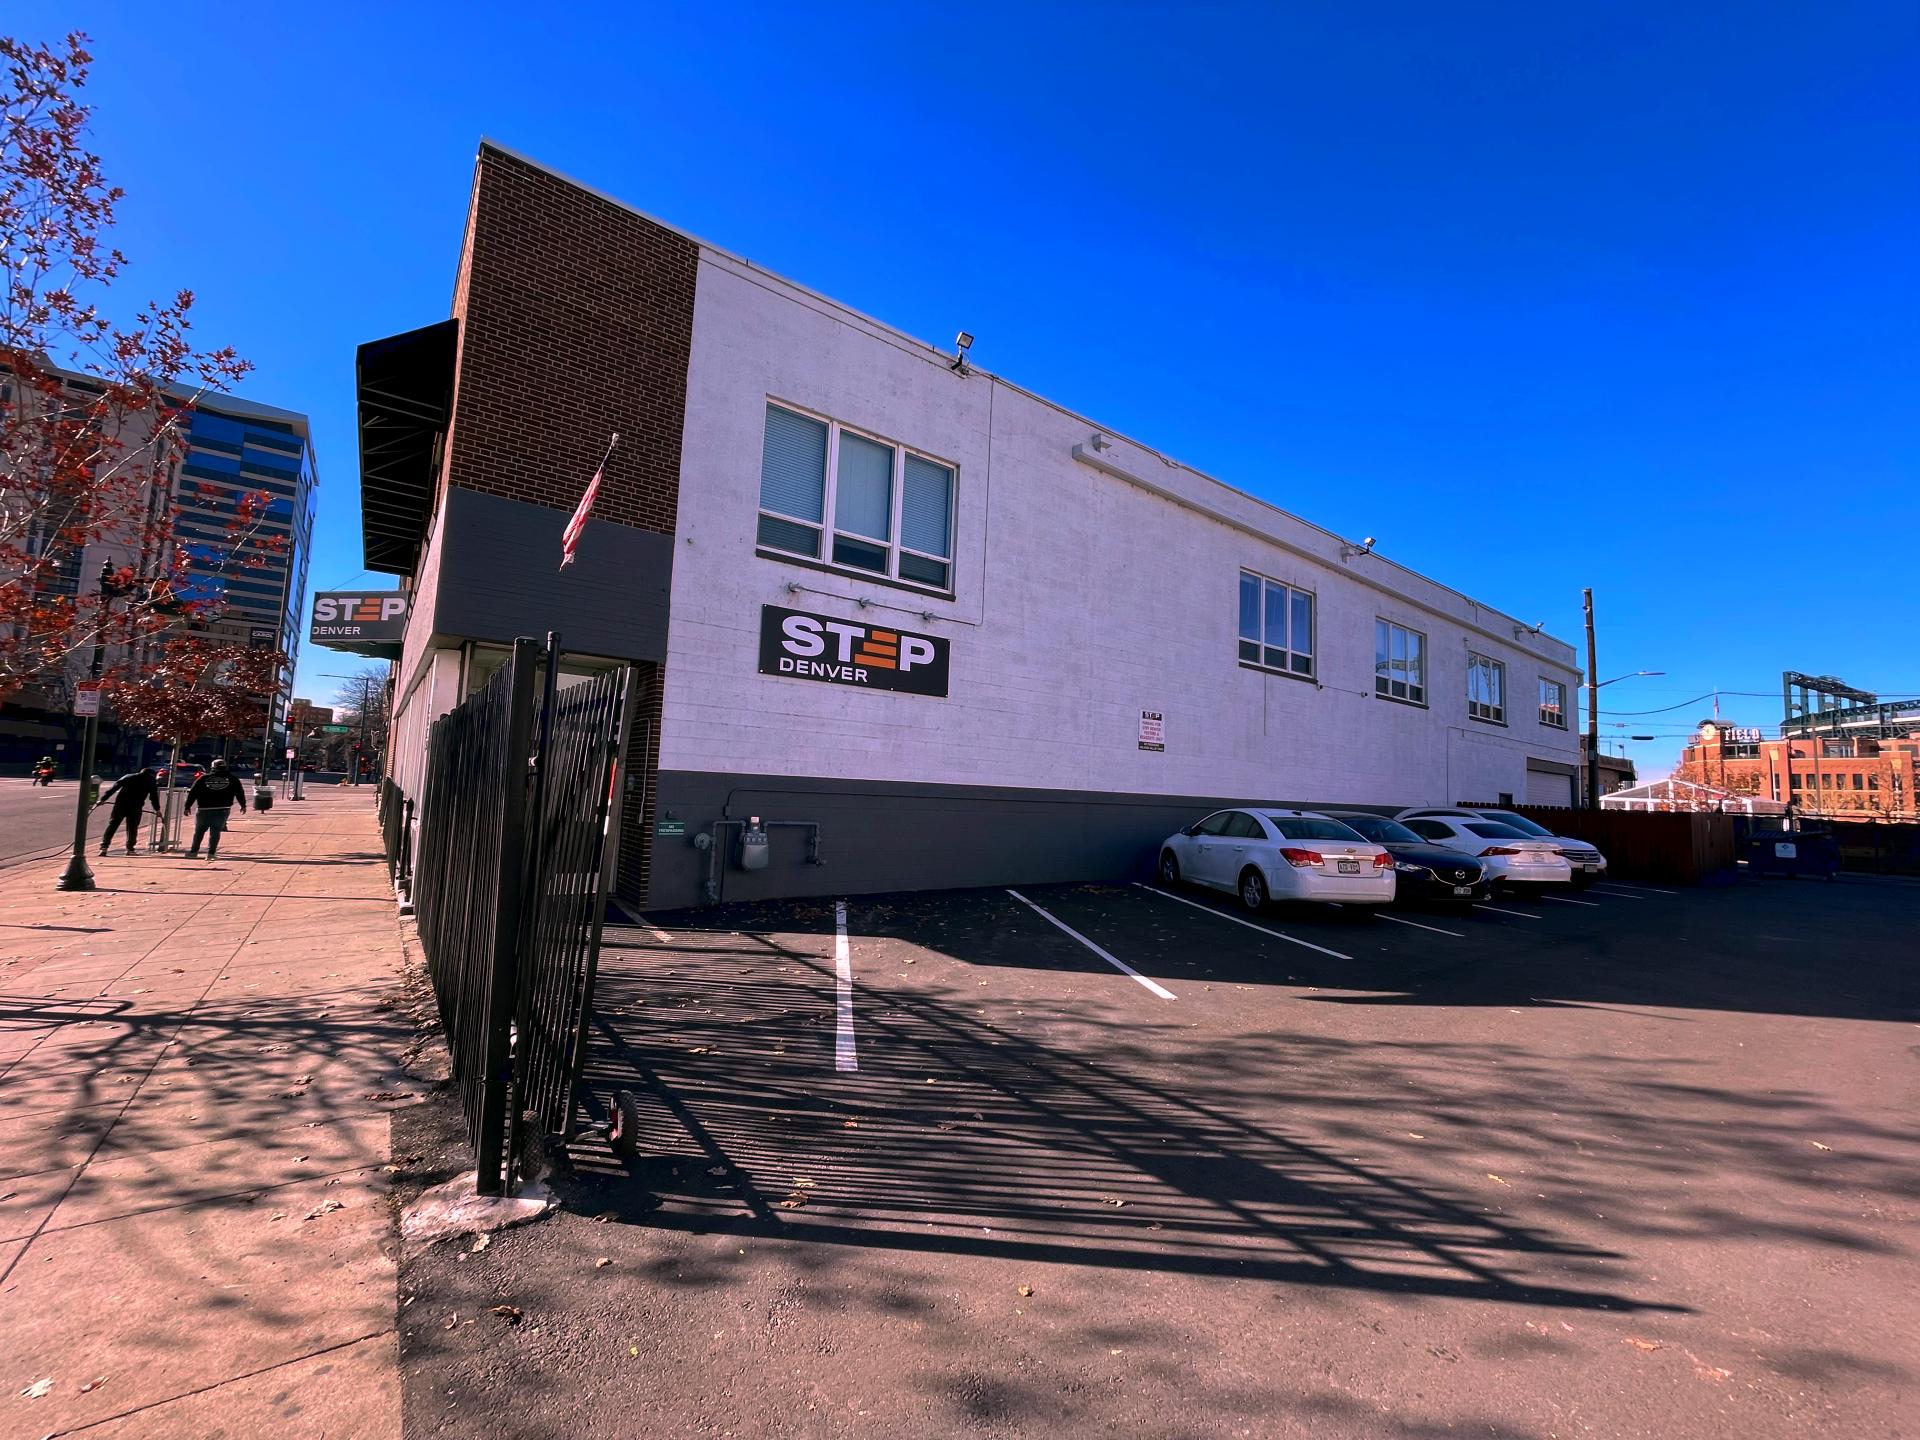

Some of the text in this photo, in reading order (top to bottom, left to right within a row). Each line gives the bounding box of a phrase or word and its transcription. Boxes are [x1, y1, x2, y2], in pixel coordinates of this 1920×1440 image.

[314, 597, 406, 621] STEP
[312, 626, 361, 635] DENVER
[781, 615, 936, 672] STEP
[779, 657, 868, 683] DENVER
[1725, 728, 1760, 741] FIELD
